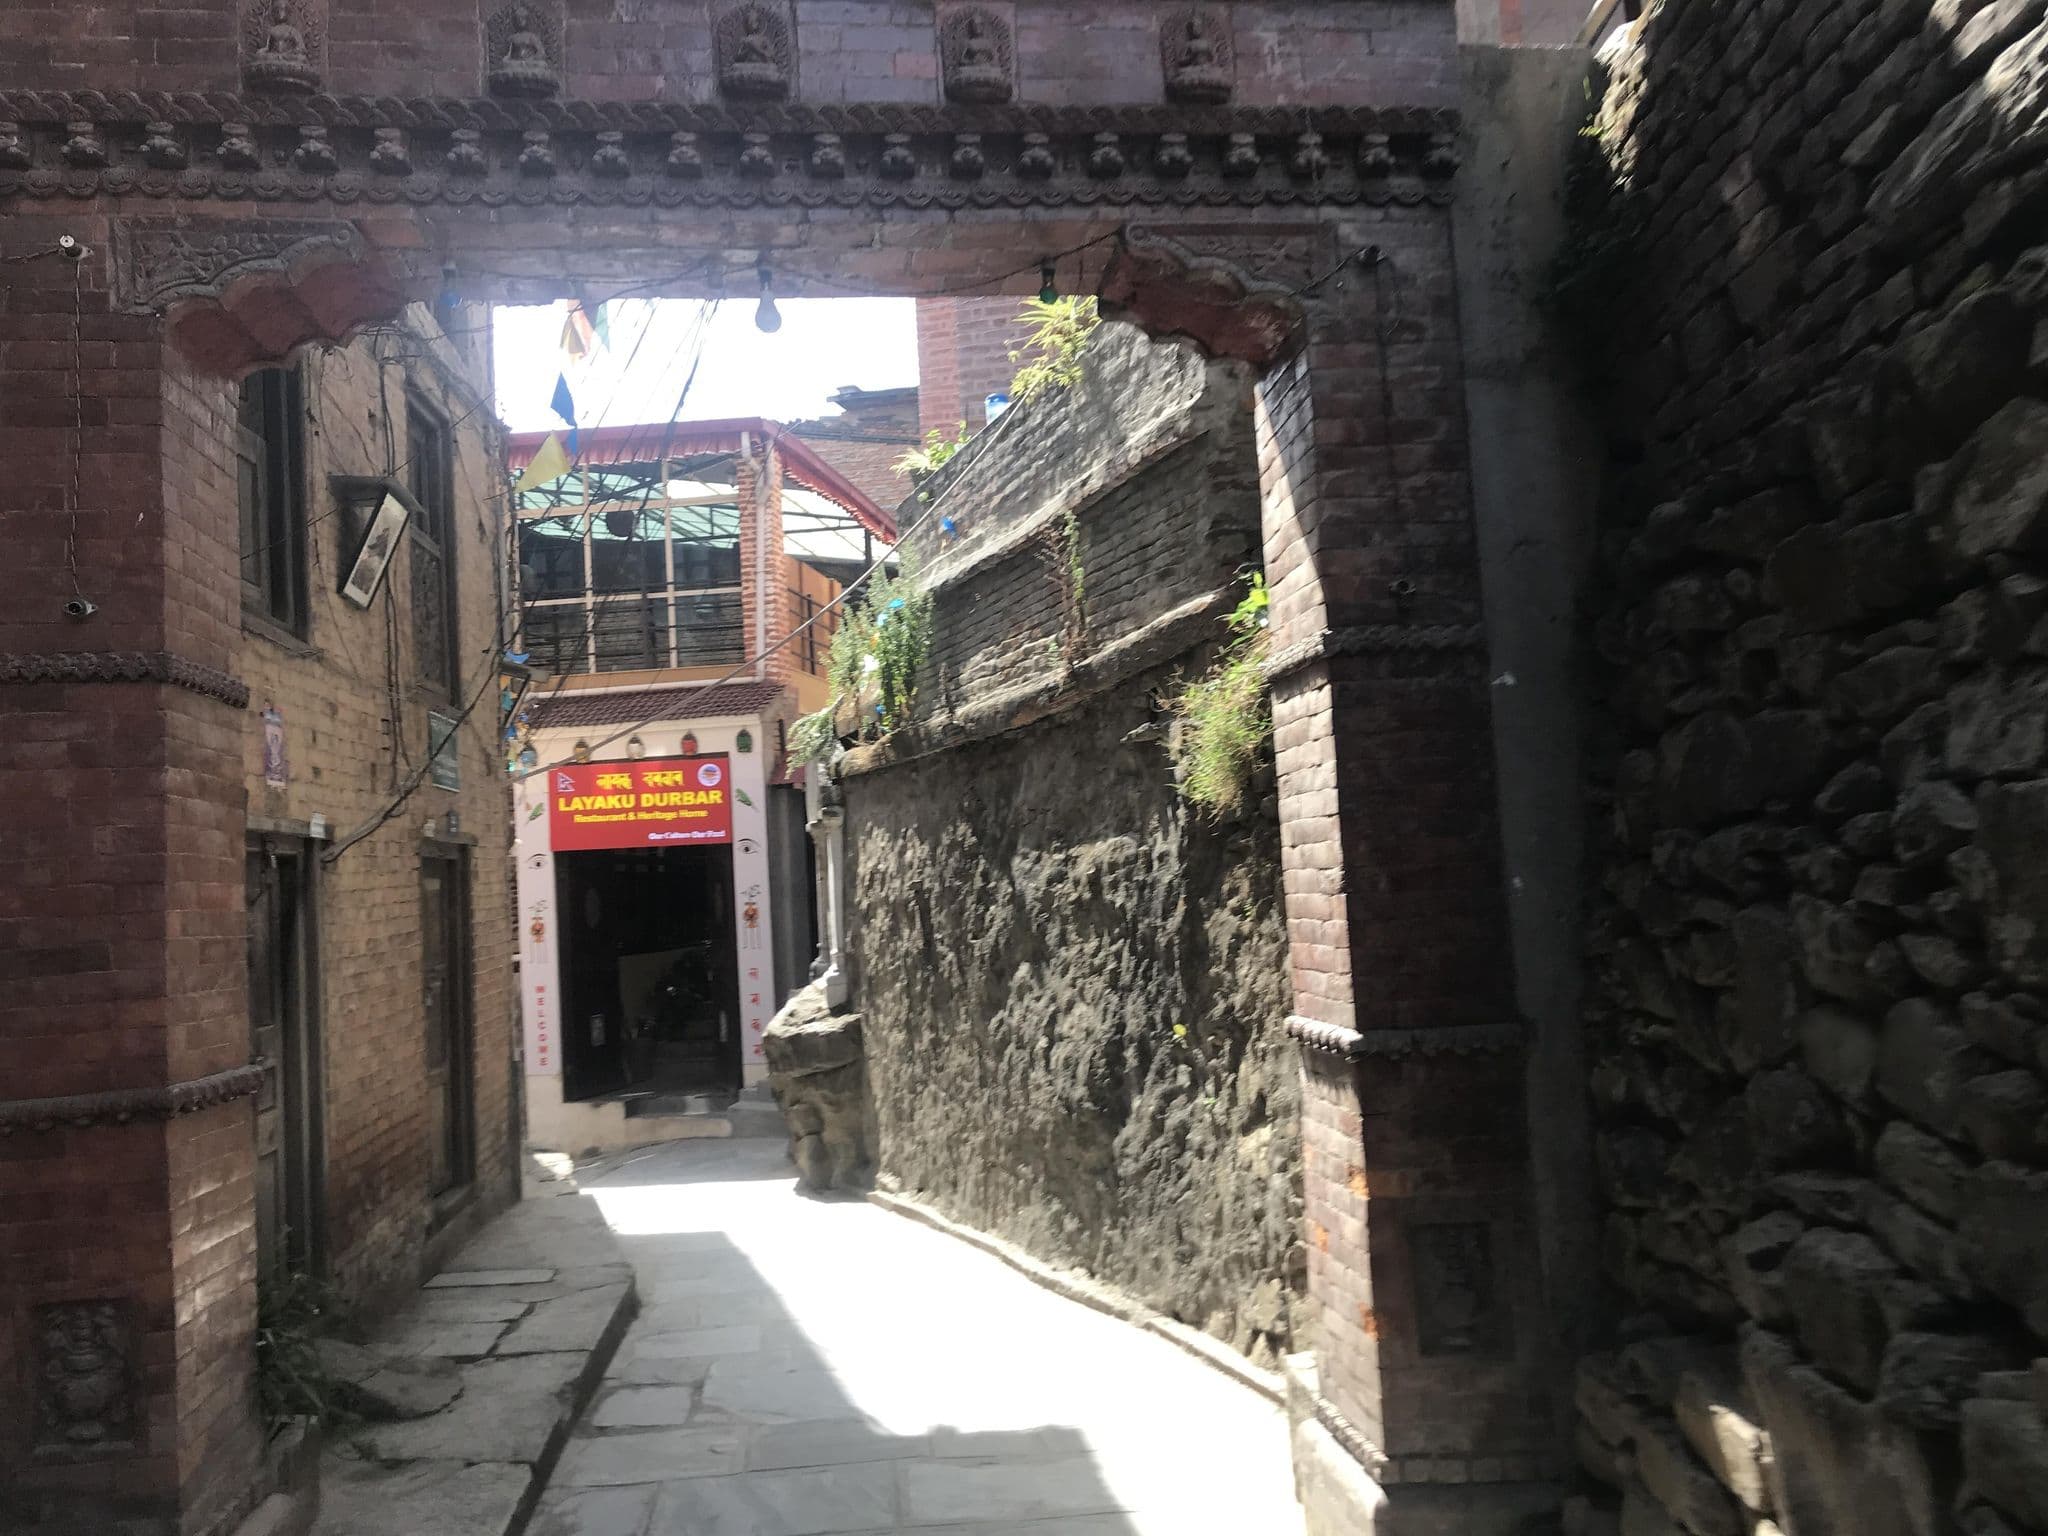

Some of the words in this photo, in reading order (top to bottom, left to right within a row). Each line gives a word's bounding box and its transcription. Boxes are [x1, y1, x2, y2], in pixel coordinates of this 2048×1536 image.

[559, 794, 635, 811] LAYAKU
[641, 790, 723, 807] DURBAR
[573, 814, 627, 823] Restaurant
[627, 812, 636, 820] &
[637, 811, 678, 821] Heritage
[679, 810, 709, 818] Home
